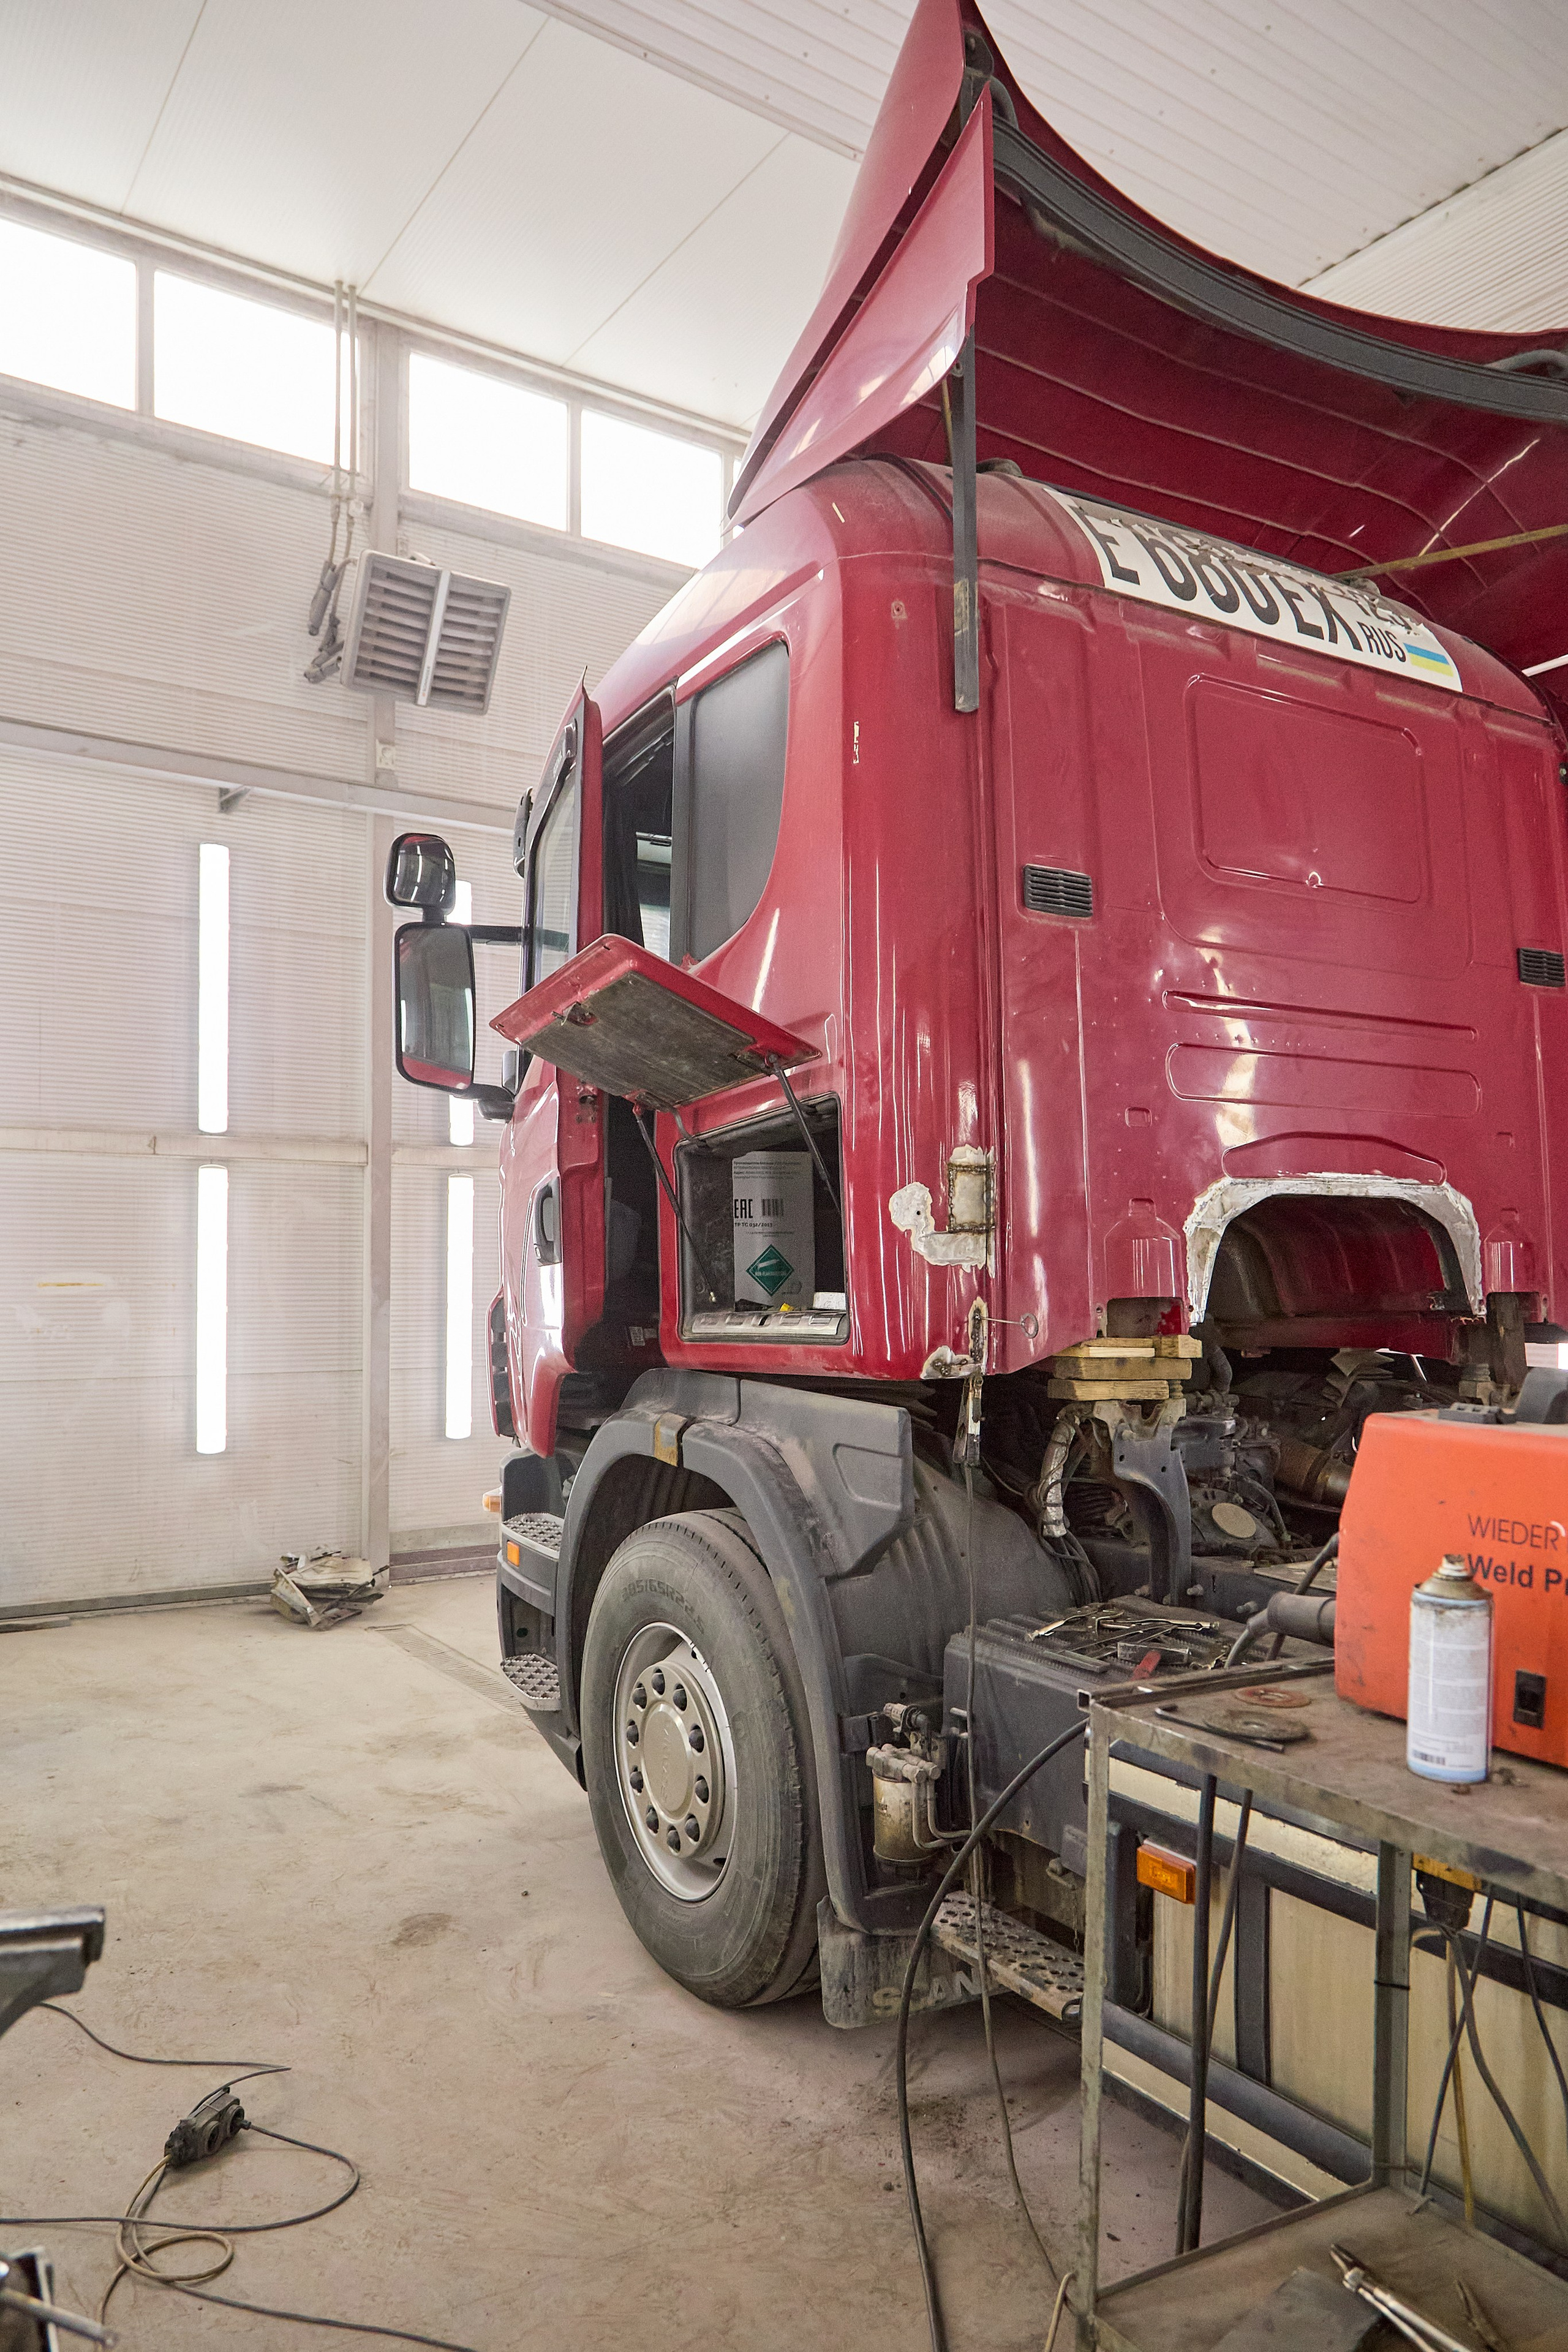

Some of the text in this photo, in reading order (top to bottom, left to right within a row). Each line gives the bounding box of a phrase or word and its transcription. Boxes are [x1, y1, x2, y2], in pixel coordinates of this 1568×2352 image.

[1356, 620, 1406, 663] RUS
[734, 1199, 753, 1219] EAC
[1468, 1513, 1559, 1551] WIEDER
[1468, 1553, 1534, 1589] Weld
